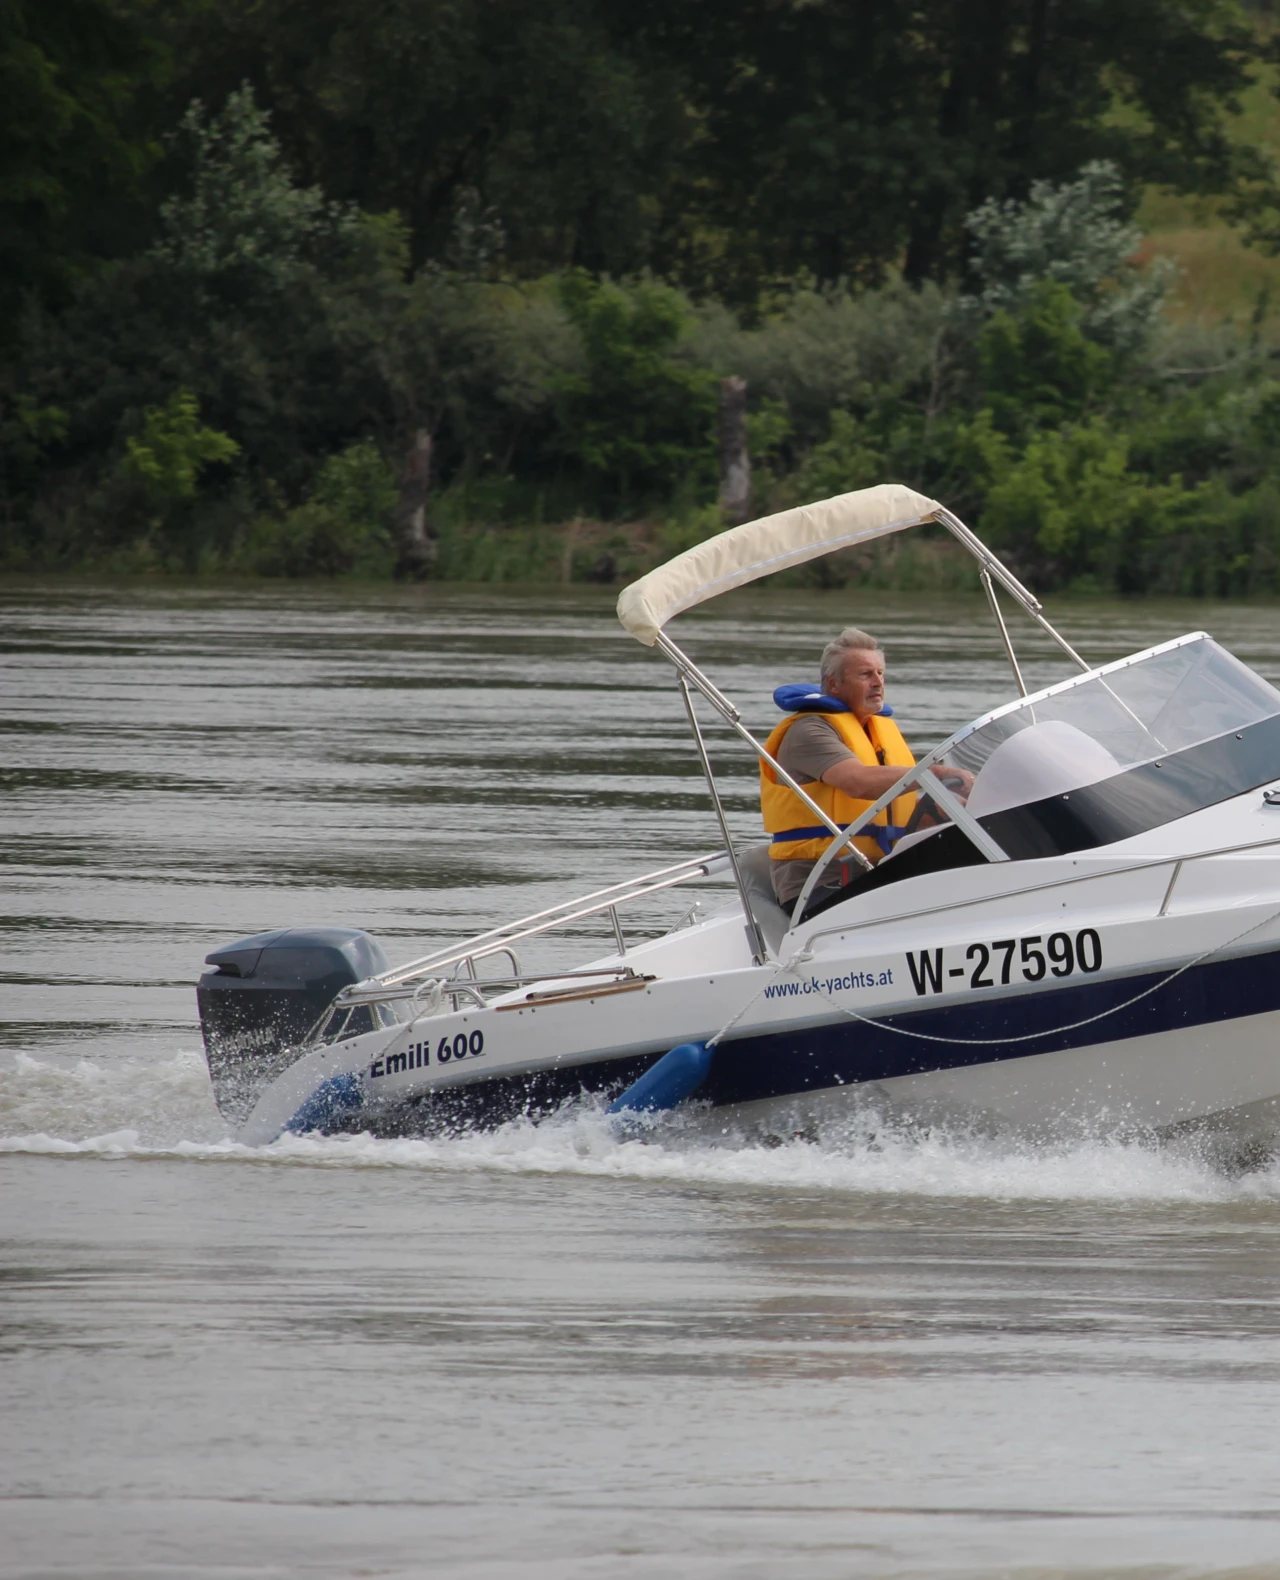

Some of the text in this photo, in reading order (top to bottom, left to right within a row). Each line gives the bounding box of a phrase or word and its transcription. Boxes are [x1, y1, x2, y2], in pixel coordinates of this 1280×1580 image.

[905, 928, 1103, 996] W-27590
[370, 1030, 484, 1078] Emili 600
